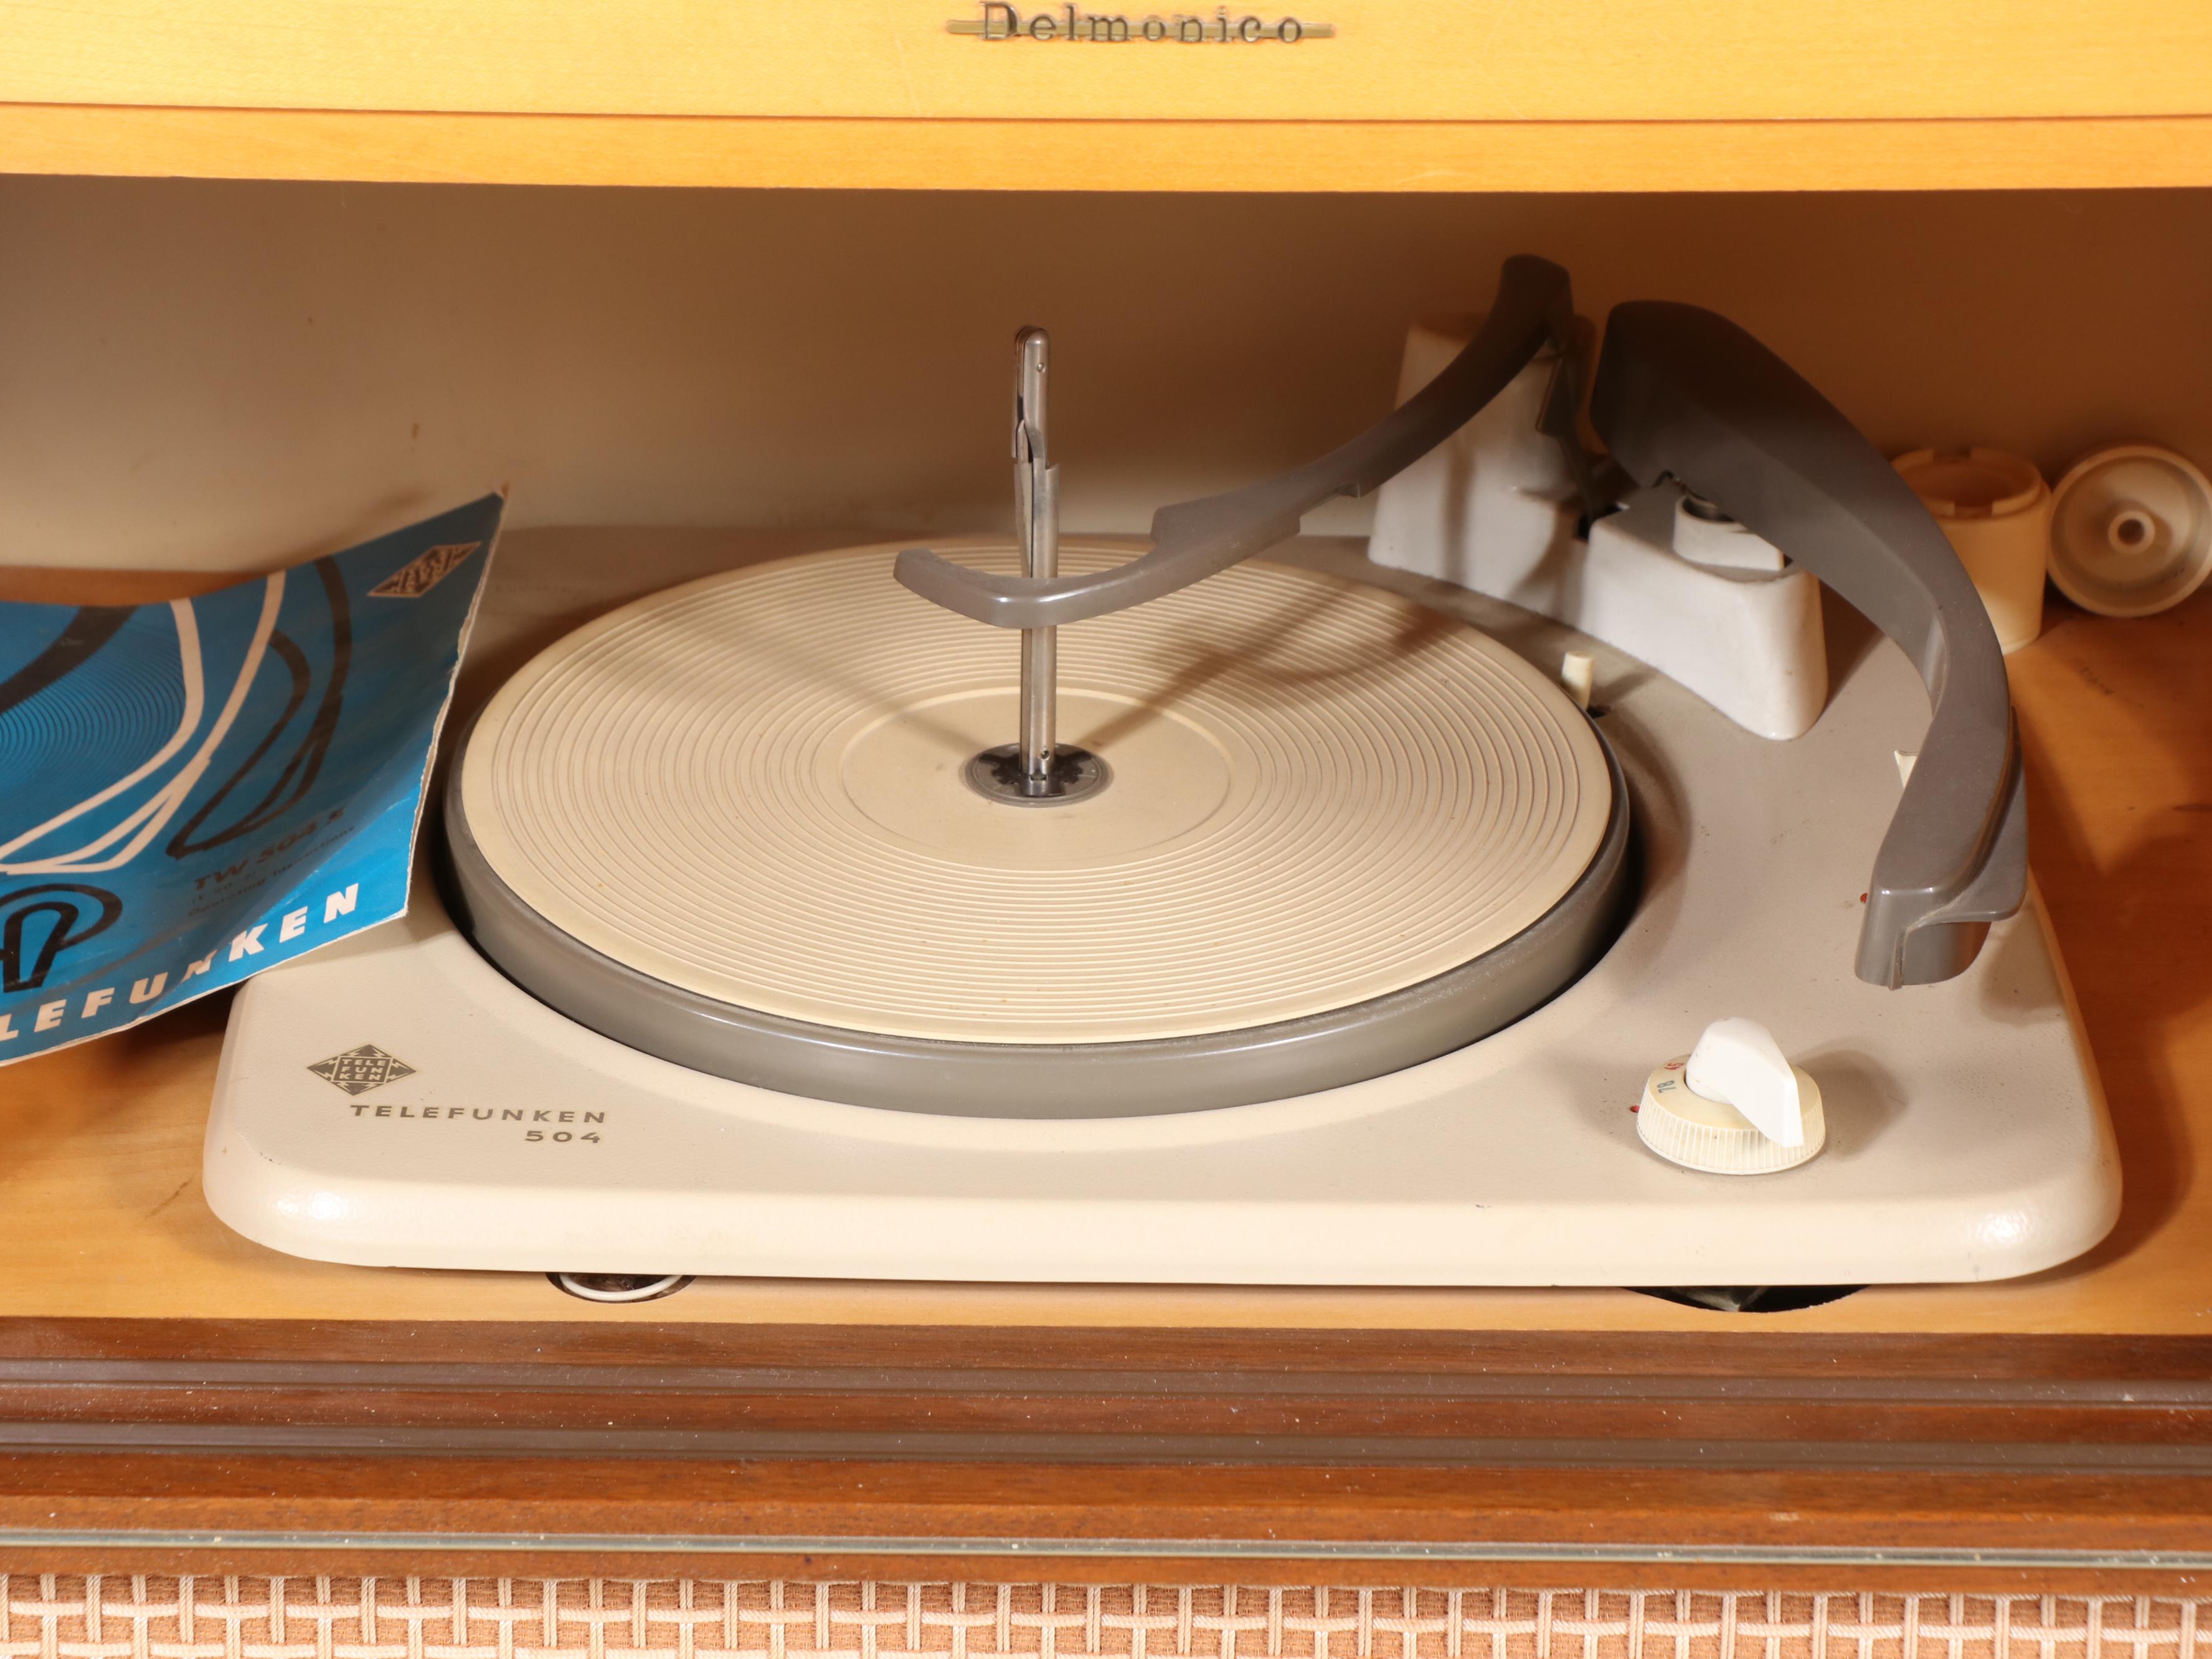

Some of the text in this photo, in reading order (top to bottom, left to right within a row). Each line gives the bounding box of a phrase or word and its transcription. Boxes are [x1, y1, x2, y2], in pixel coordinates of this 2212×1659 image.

[979, 1, 1303, 42] Delmonico
[1657, 1080, 1676, 1094] 78
[350, 1105, 606, 1123] TELEFUNKEN
[524, 1130, 602, 1144] 504
